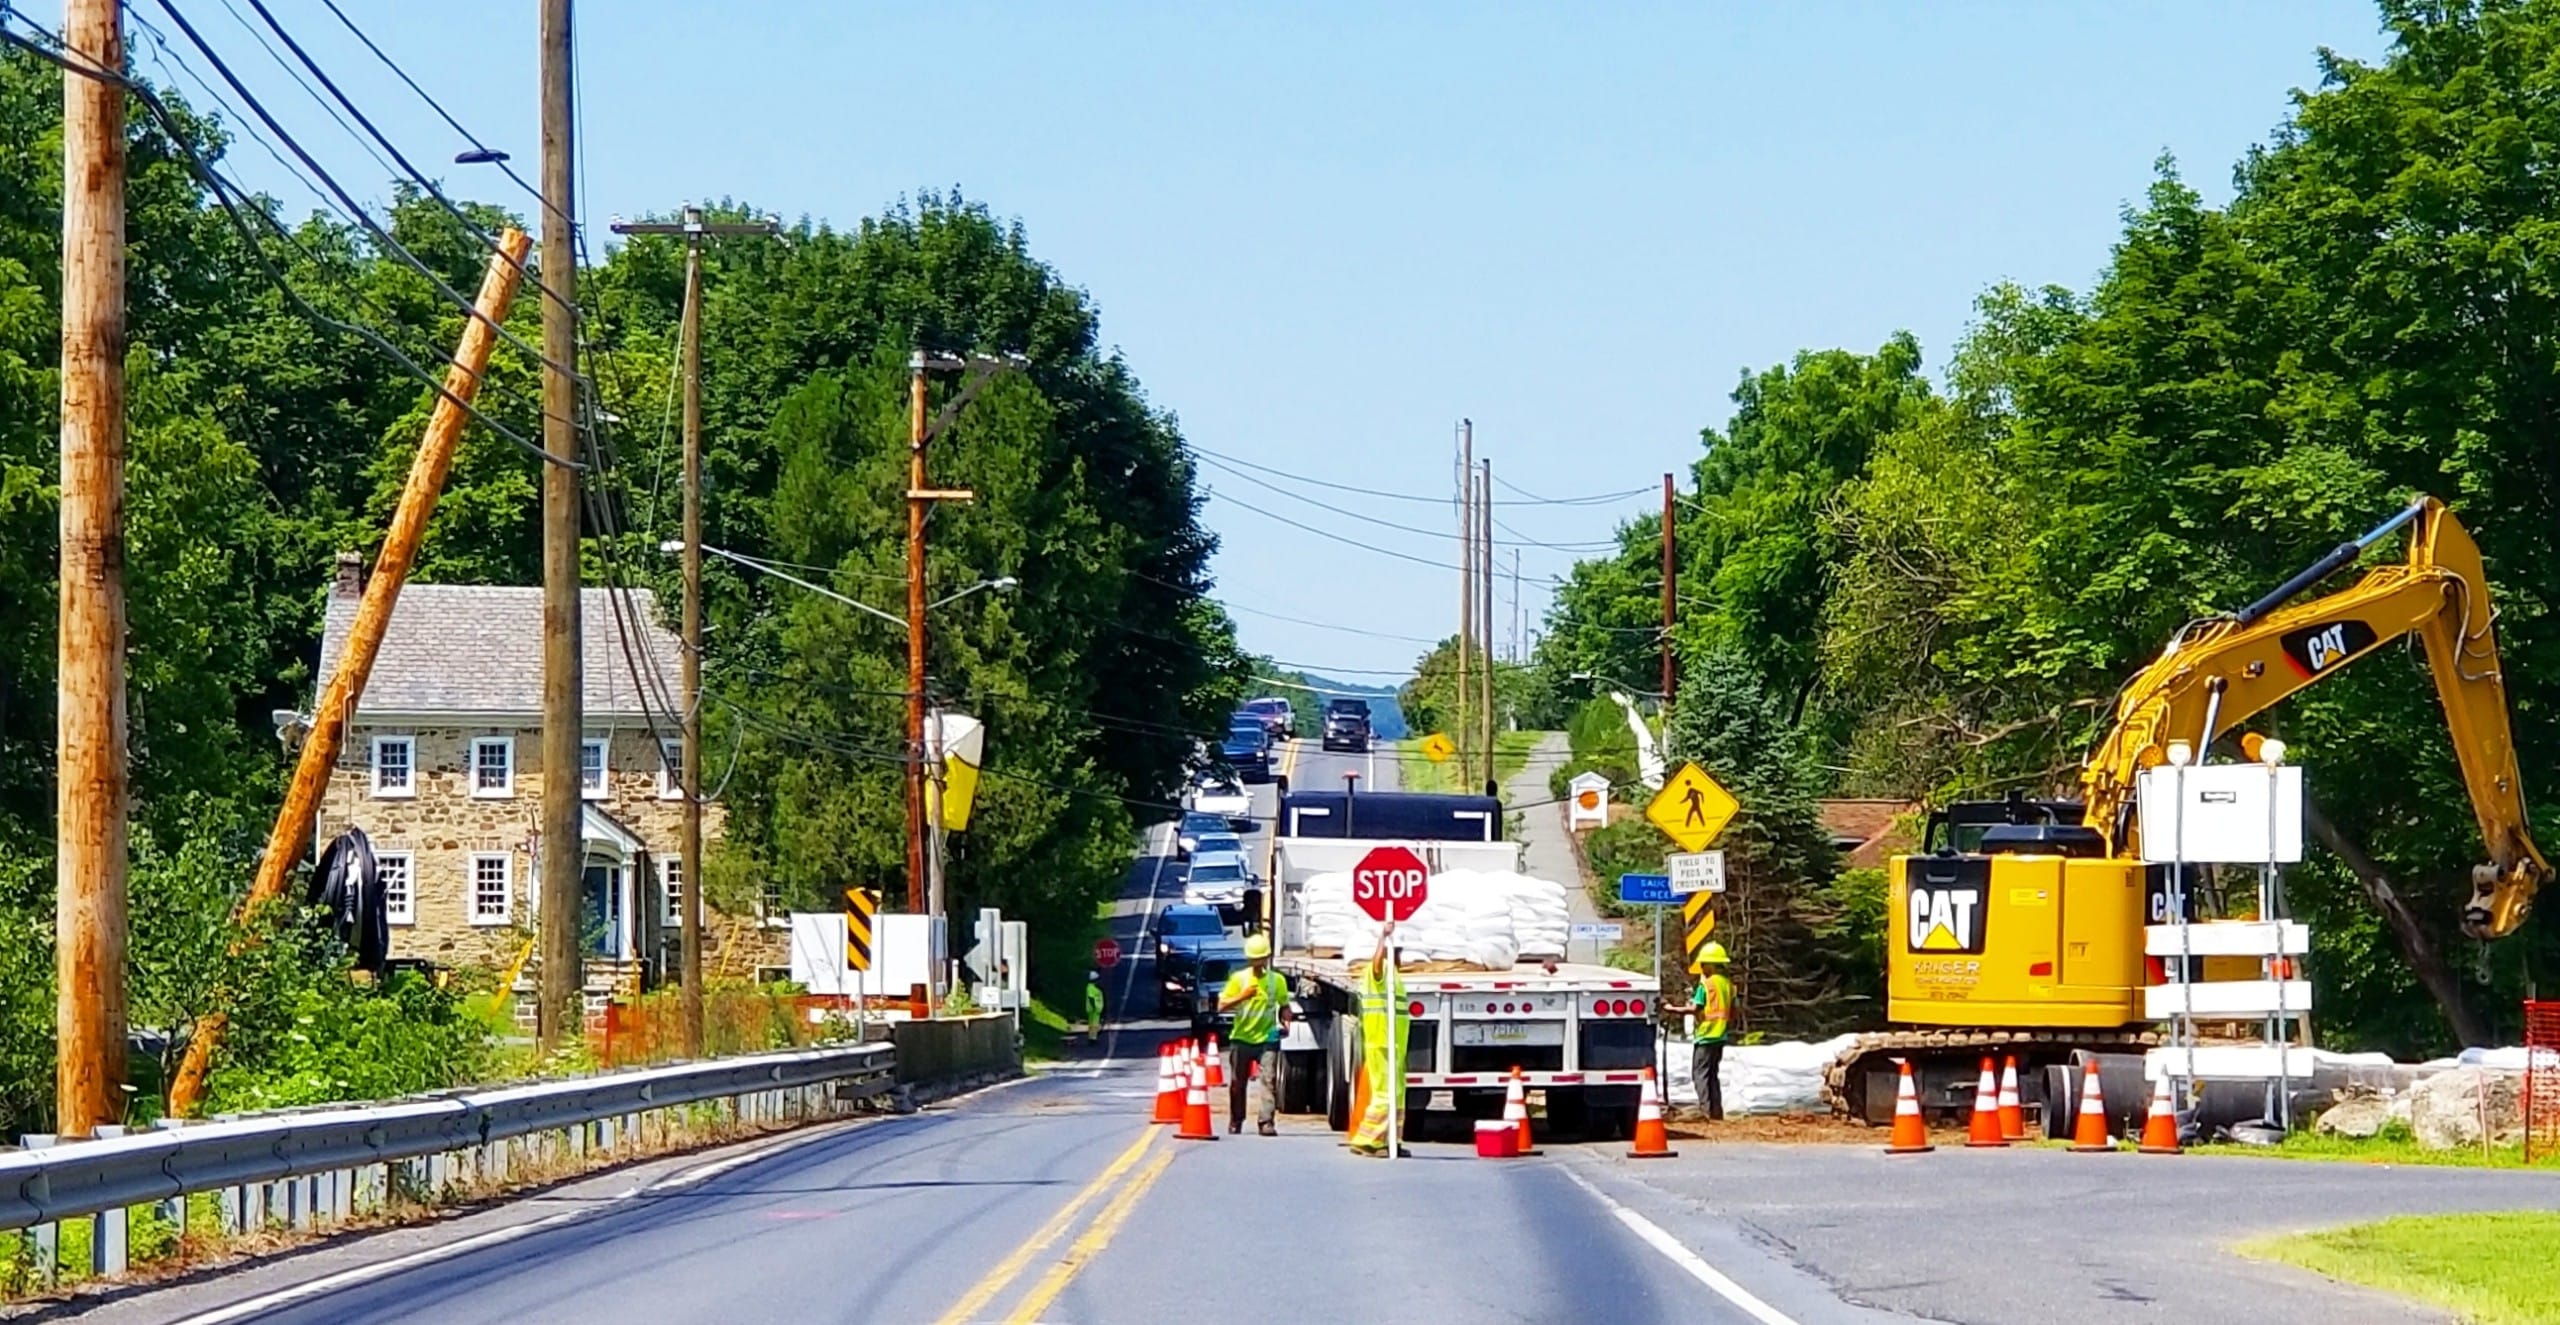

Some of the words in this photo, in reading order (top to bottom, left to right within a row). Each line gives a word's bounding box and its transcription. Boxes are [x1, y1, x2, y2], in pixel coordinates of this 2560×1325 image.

[2307, 623, 2347, 671] CAT
[1678, 858, 1700, 867] YIELD
[1705, 856, 1716, 865] TO
[1680, 867, 1701, 878] PEDS
[1705, 867, 1714, 876] IN
[1358, 869, 1423, 899] STOP
[1641, 879, 1668, 888] SAUC
[1674, 878, 1719, 889] CROSSWALK
[1910, 888, 1978, 950] CAT
[1095, 947, 1121, 959] STOP
